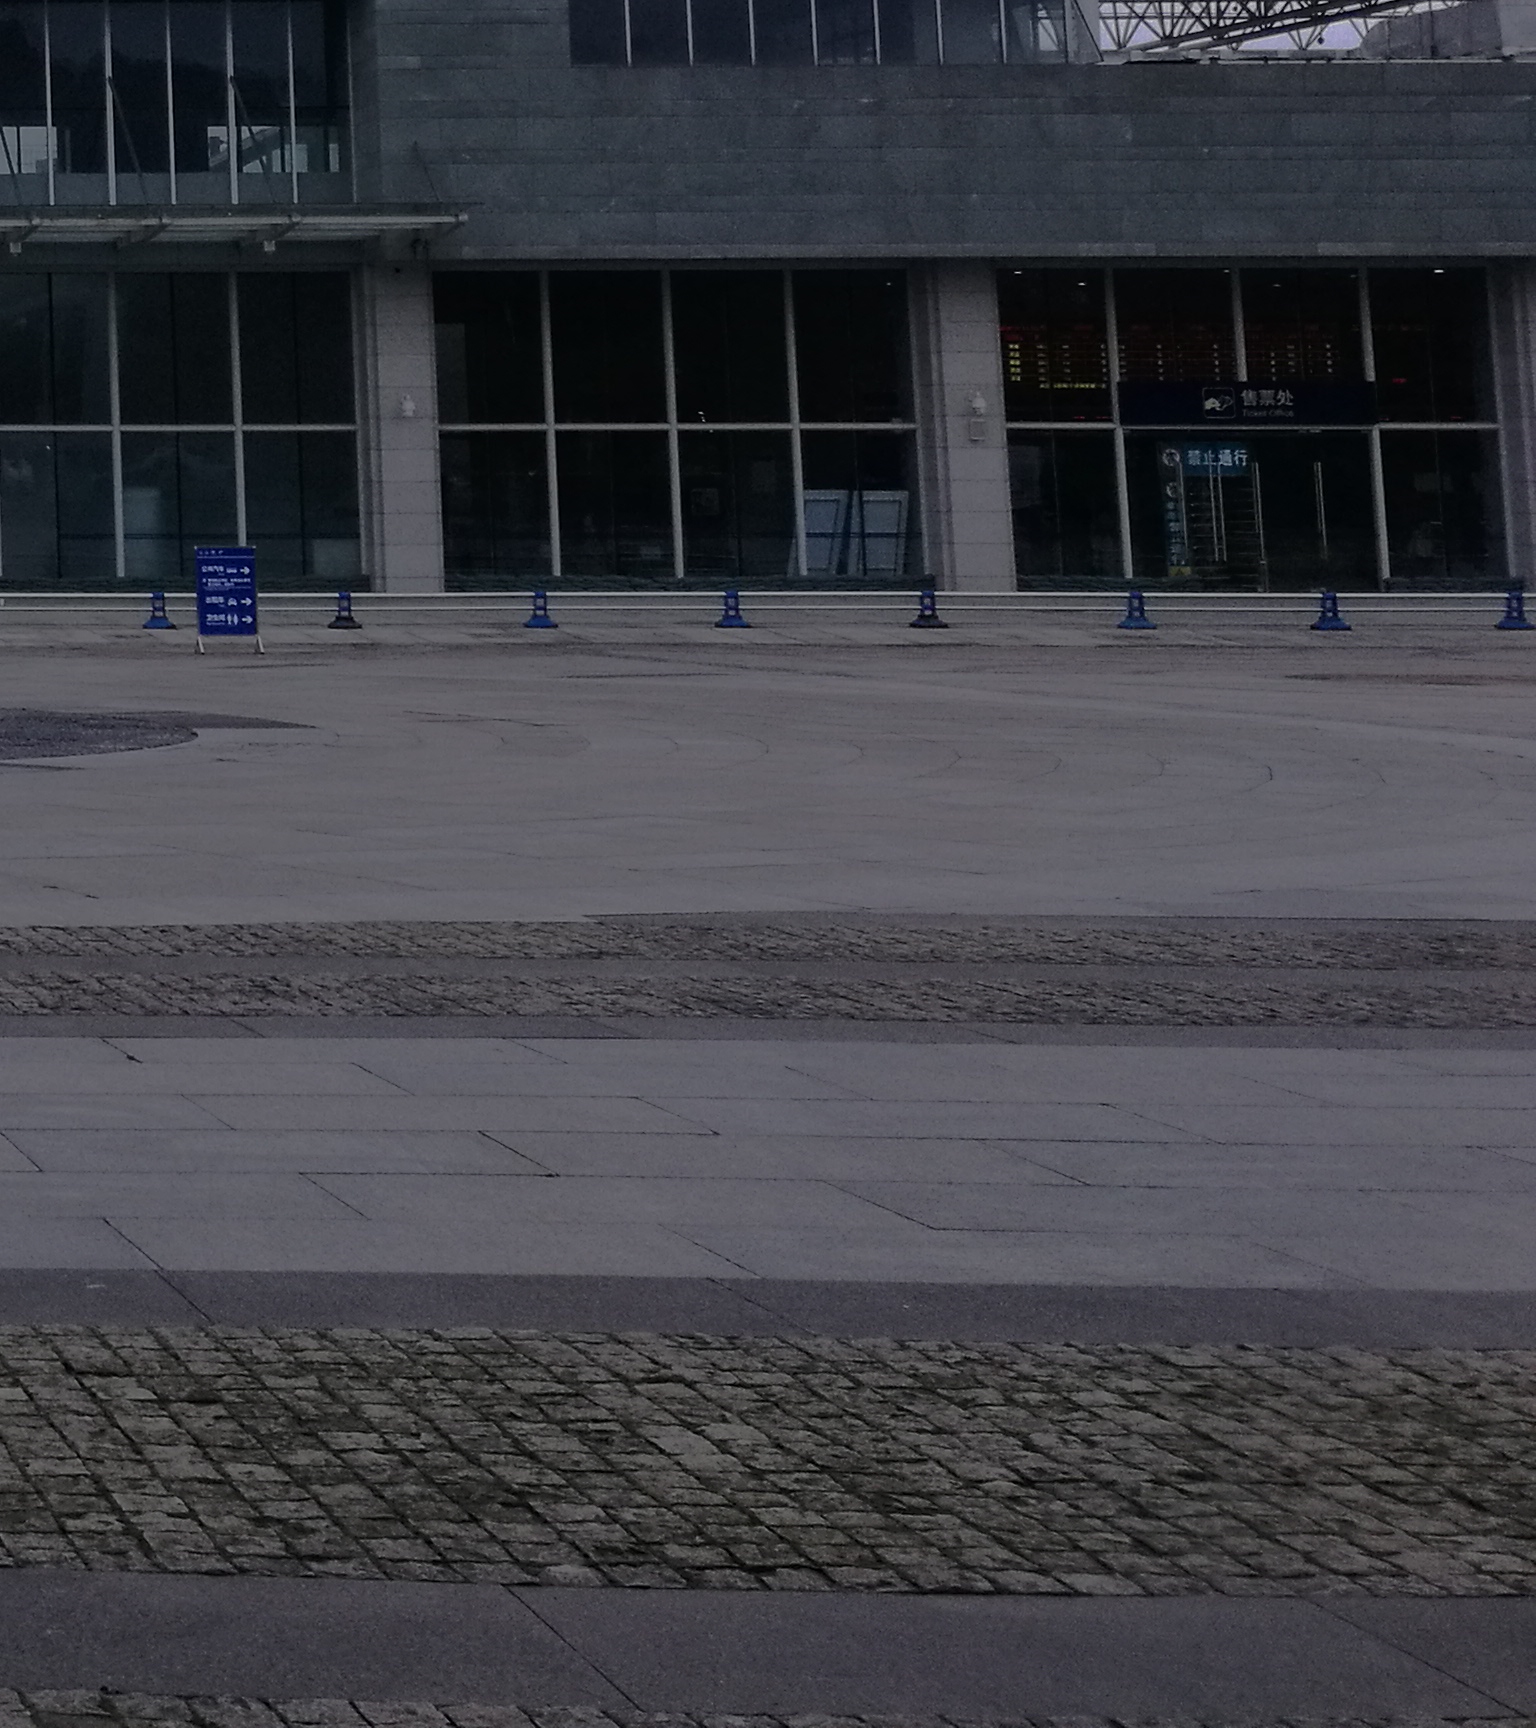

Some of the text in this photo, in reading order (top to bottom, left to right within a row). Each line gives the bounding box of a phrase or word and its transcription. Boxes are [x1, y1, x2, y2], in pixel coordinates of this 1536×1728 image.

[1240, 388, 1294, 406] 售票处
[1187, 448, 1249, 467] 禁止通行
